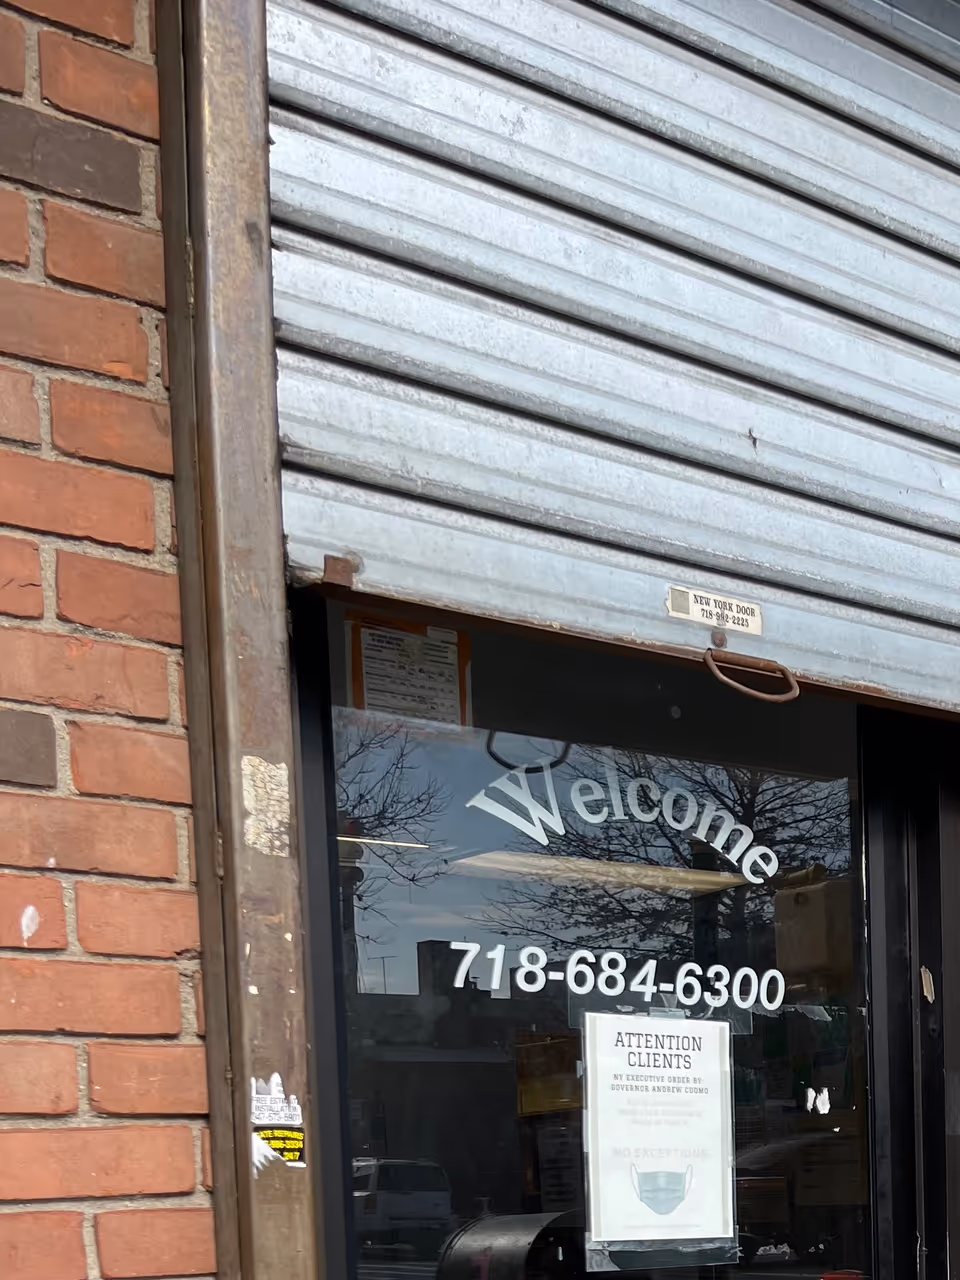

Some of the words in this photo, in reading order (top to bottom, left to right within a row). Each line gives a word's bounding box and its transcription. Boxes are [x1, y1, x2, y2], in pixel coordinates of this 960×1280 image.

[693, 594, 711, 607] NEW
[713, 599, 733, 612] YORK
[736, 604, 756, 617] DOOR
[466, 755, 781, 887] Welcome
[450, 941, 786, 1011] 718-684-6300
[614, 1032, 702, 1052] ATTENTION
[627, 1051, 692, 1070] CLIENTS
[611, 1084, 650, 1092] GOVERNOR
[652, 1085, 682, 1093] ANDREW
[685, 1086, 709, 1094] CUOMO
[626, 1074, 665, 1084] EXECUTIVE
[668, 1076, 692, 1084] ORDER
